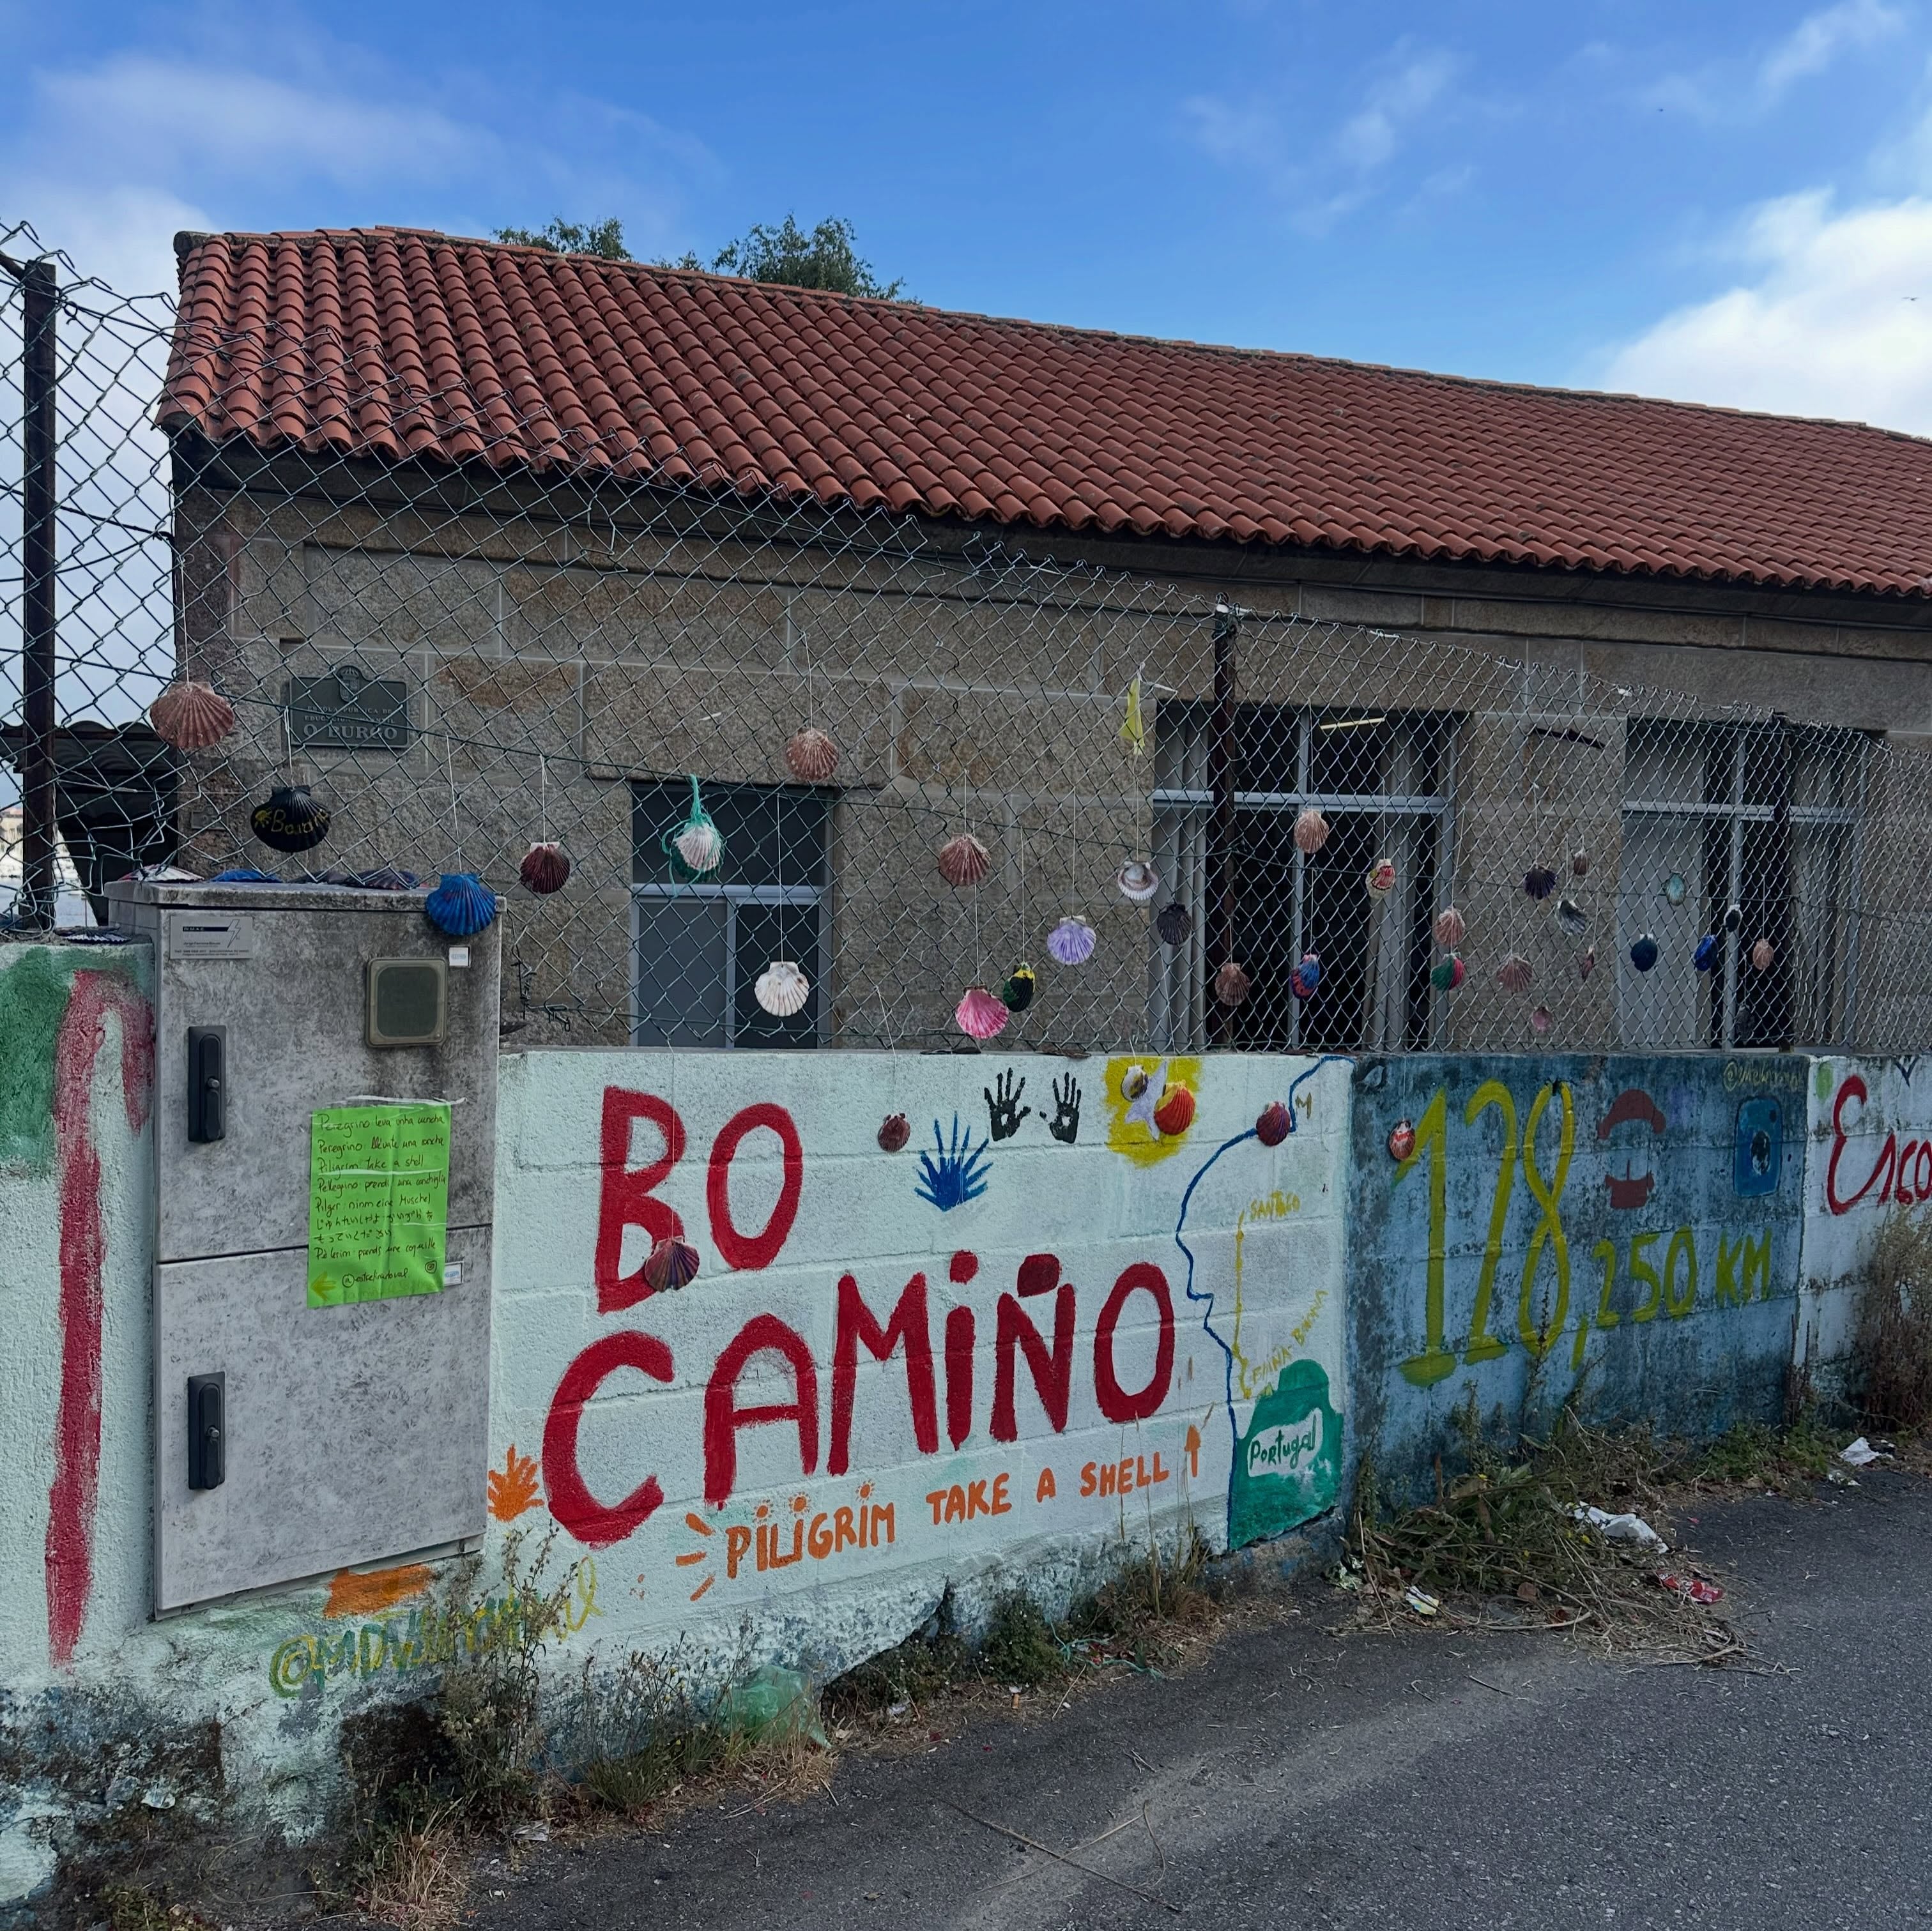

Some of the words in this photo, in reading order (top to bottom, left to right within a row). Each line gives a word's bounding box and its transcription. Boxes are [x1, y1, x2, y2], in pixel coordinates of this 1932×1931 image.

[303, 724, 318, 737] O
[317, 1113, 370, 1138] Peregrino
[318, 1139, 362, 1159] Peregrino
[394, 1159, 399, 1168] a
[404, 1154, 424, 1168] shell
[314, 1196, 341, 1217] Pilger
[595, 1087, 802, 1313] BO
[1714, 1226, 1772, 1308] KM
[926, 1473, 1011, 1525] TAKE
[1037, 1469, 1057, 1502] A
[1080, 1450, 1169, 1497] SHELL
